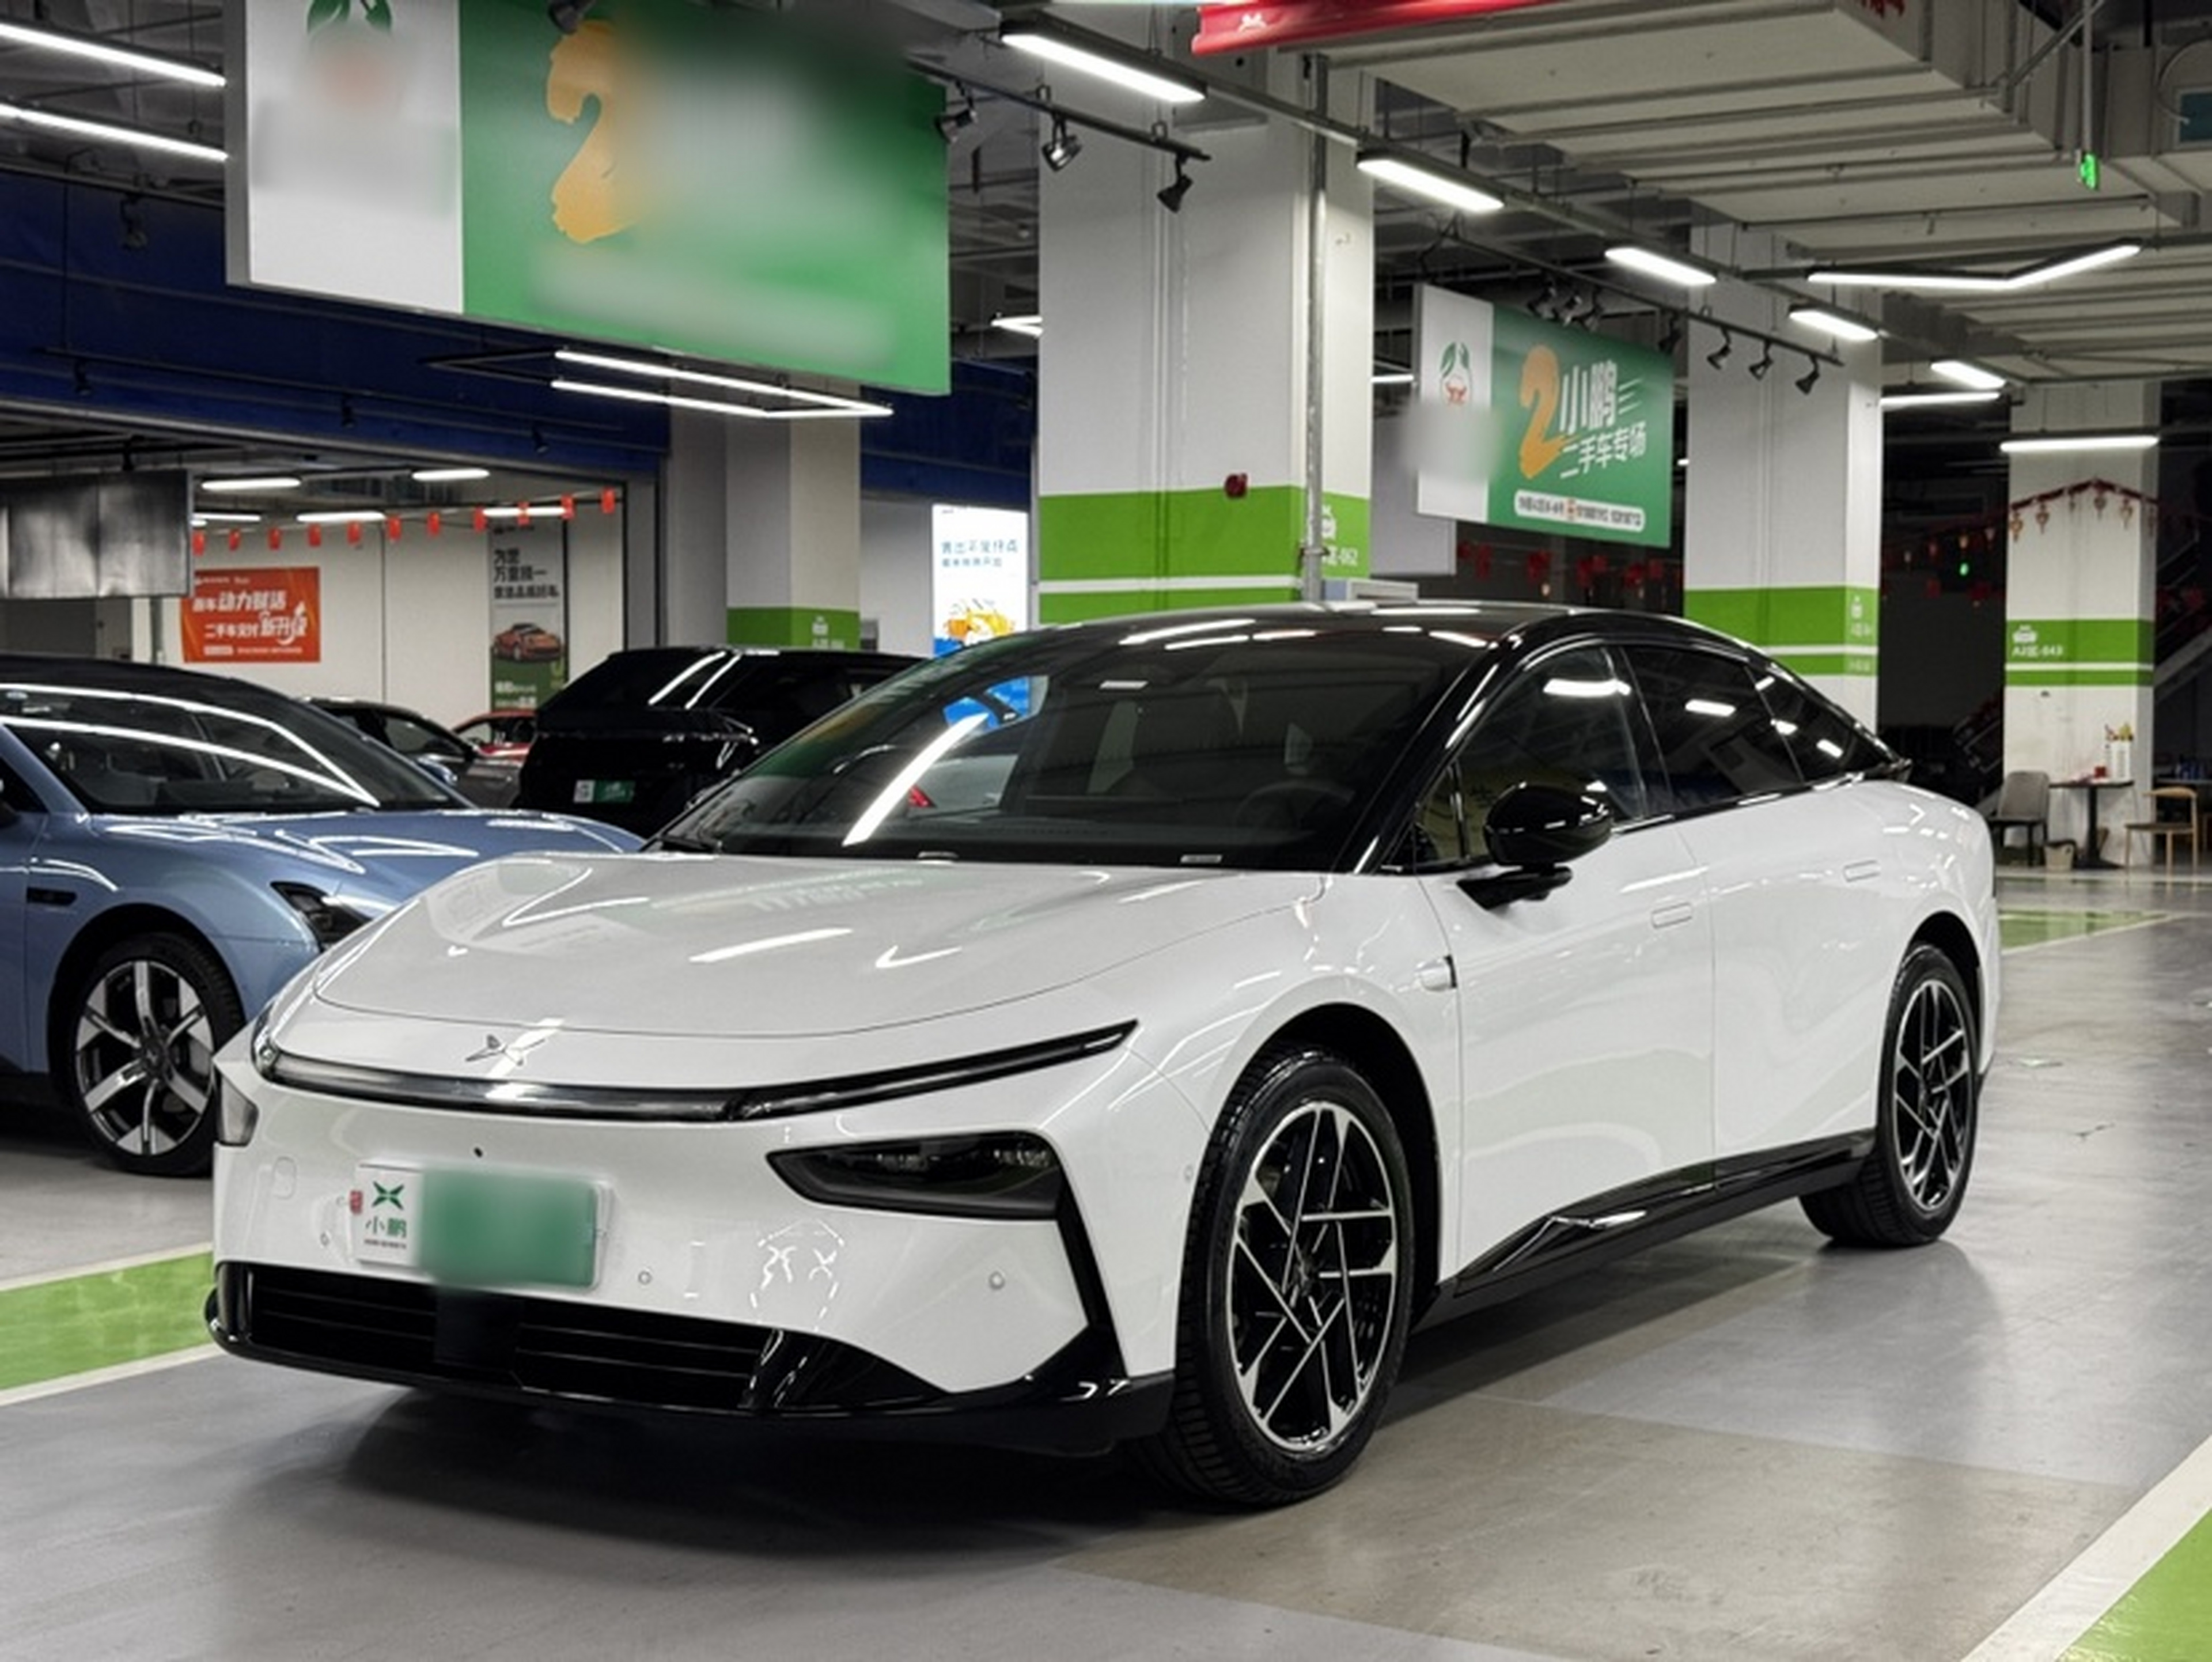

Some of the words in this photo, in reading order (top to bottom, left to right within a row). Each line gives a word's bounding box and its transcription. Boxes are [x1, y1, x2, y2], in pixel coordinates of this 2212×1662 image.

[1519, 344, 1580, 480] 2
[1560, 360, 1617, 436] 小鹏
[1560, 420, 1646, 479] 二手车专场
